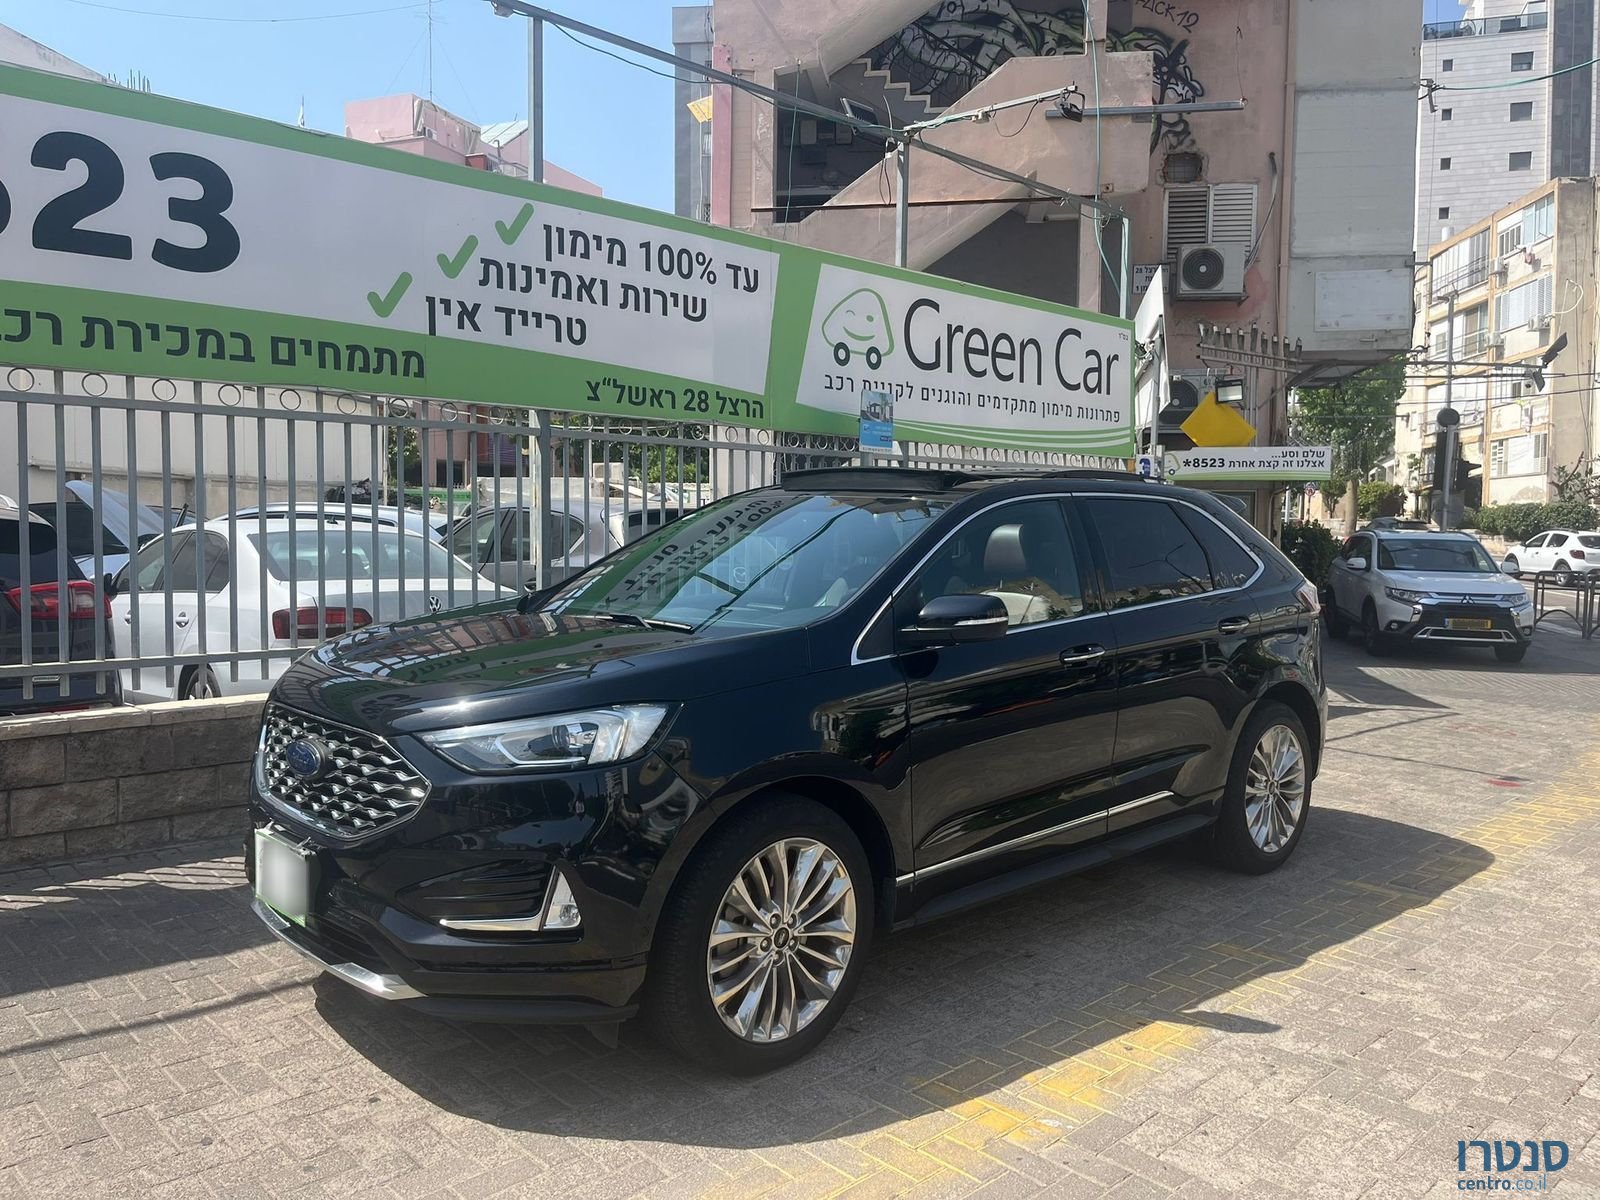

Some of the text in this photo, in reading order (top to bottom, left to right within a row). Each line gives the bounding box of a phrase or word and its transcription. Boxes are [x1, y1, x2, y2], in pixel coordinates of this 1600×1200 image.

[0, 131, 241, 273] 23
[543, 223, 760, 293] עד 100% מימון
[479, 257, 707, 322] שירות ואמינות
[425, 295, 587, 347] טרייד אין
[0, 308, 425, 378] מתמחים במכירת רכ
[903, 297, 1120, 396] Green Car
[824, 374, 854, 392] רכב
[683, 388, 709, 414] 28
[715, 390, 764, 419] הרצל
[921, 387, 970, 406] והוגנים
[977, 393, 1037, 415] מתקדמים
[1042, 401, 1072, 418] מימון
[1077, 406, 1120, 423] פתרונות
[1228, 459, 1255, 468] אחרת
[1282, 459, 1293, 468] זה
[1296, 459, 1325, 468] אצלנו
[1302, 449, 1325, 458] שלם
[1258, 459, 1279, 469] קצת
